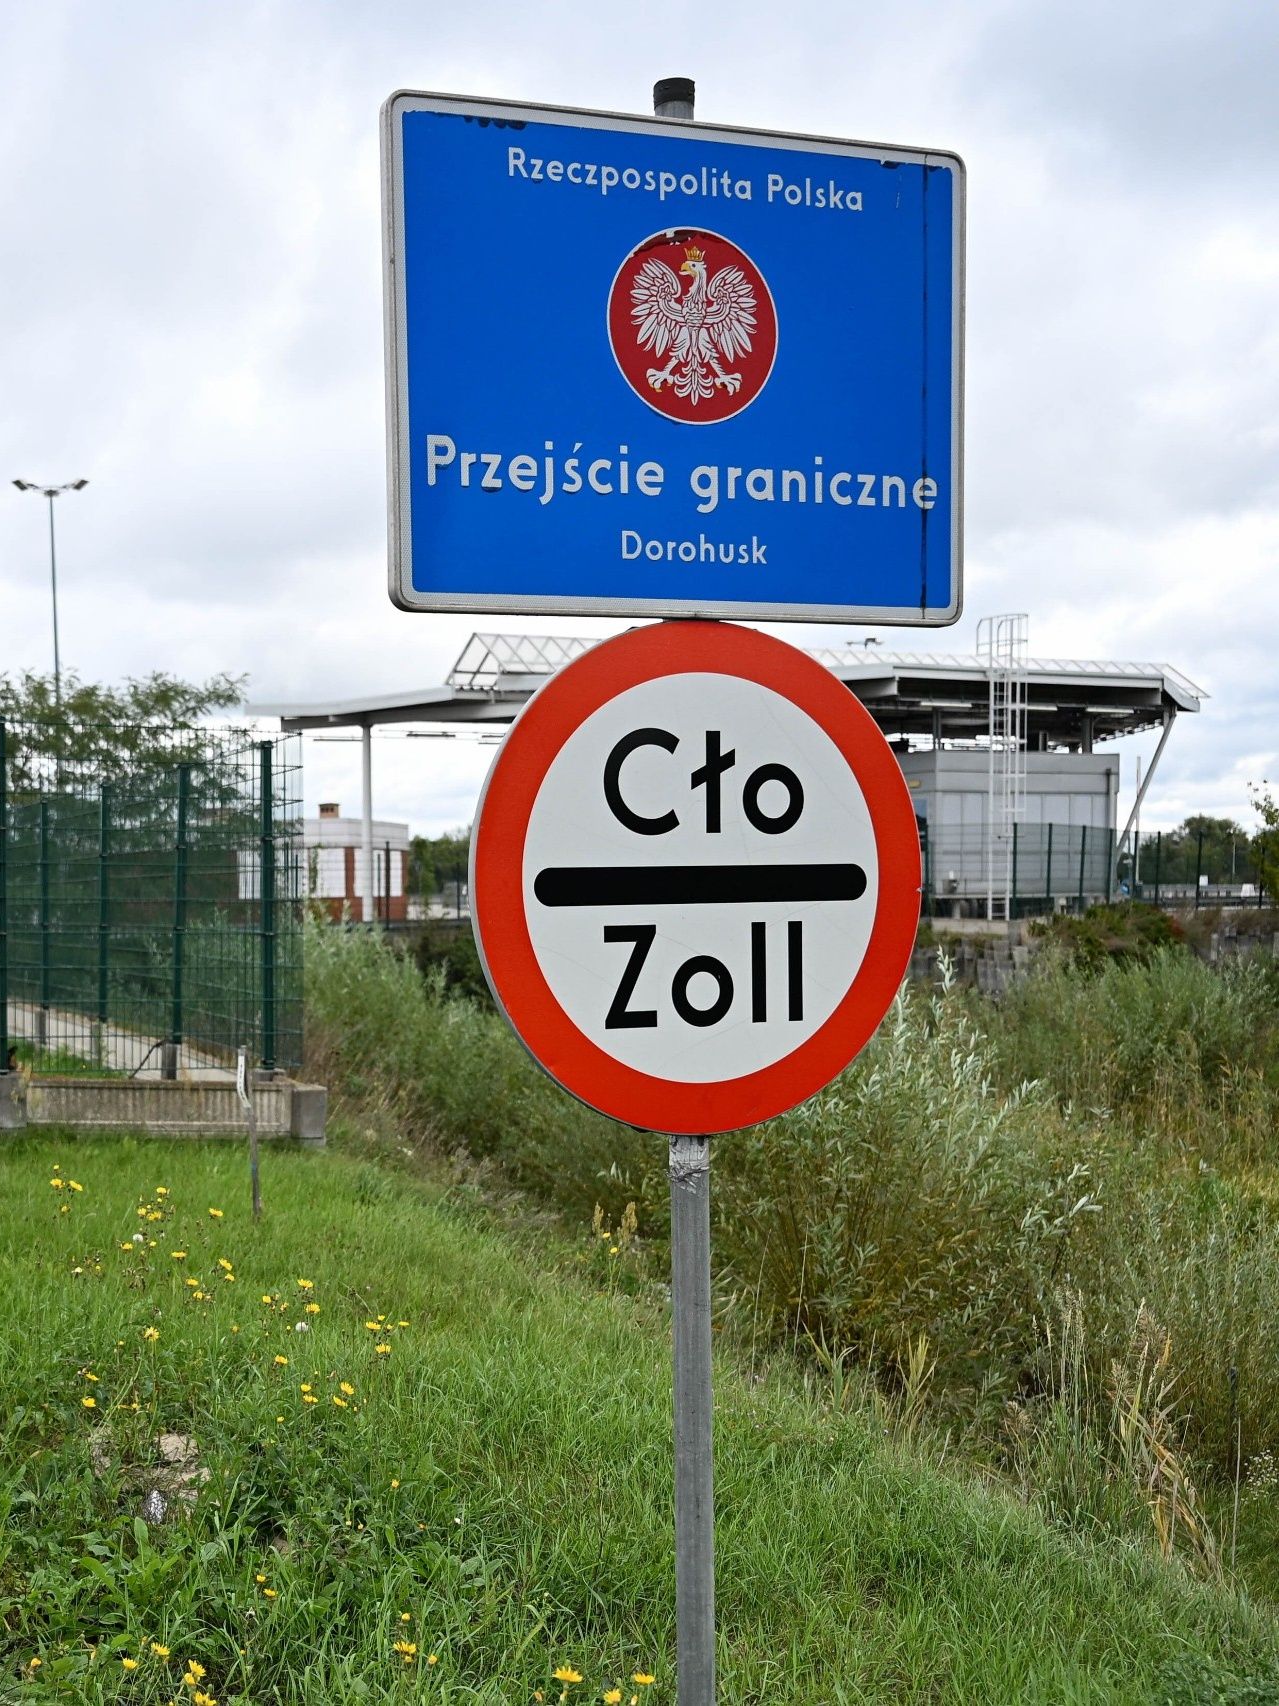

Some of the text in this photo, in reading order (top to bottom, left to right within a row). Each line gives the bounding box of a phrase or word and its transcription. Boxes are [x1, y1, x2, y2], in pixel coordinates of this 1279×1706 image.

[508, 147, 864, 212] Rzeczpospolita Polska
[426, 434, 939, 514] Przejście graniczne
[621, 529, 768, 566] Dorohusk
[604, 727, 805, 836] Cło
[604, 920, 804, 1030] Zoll
